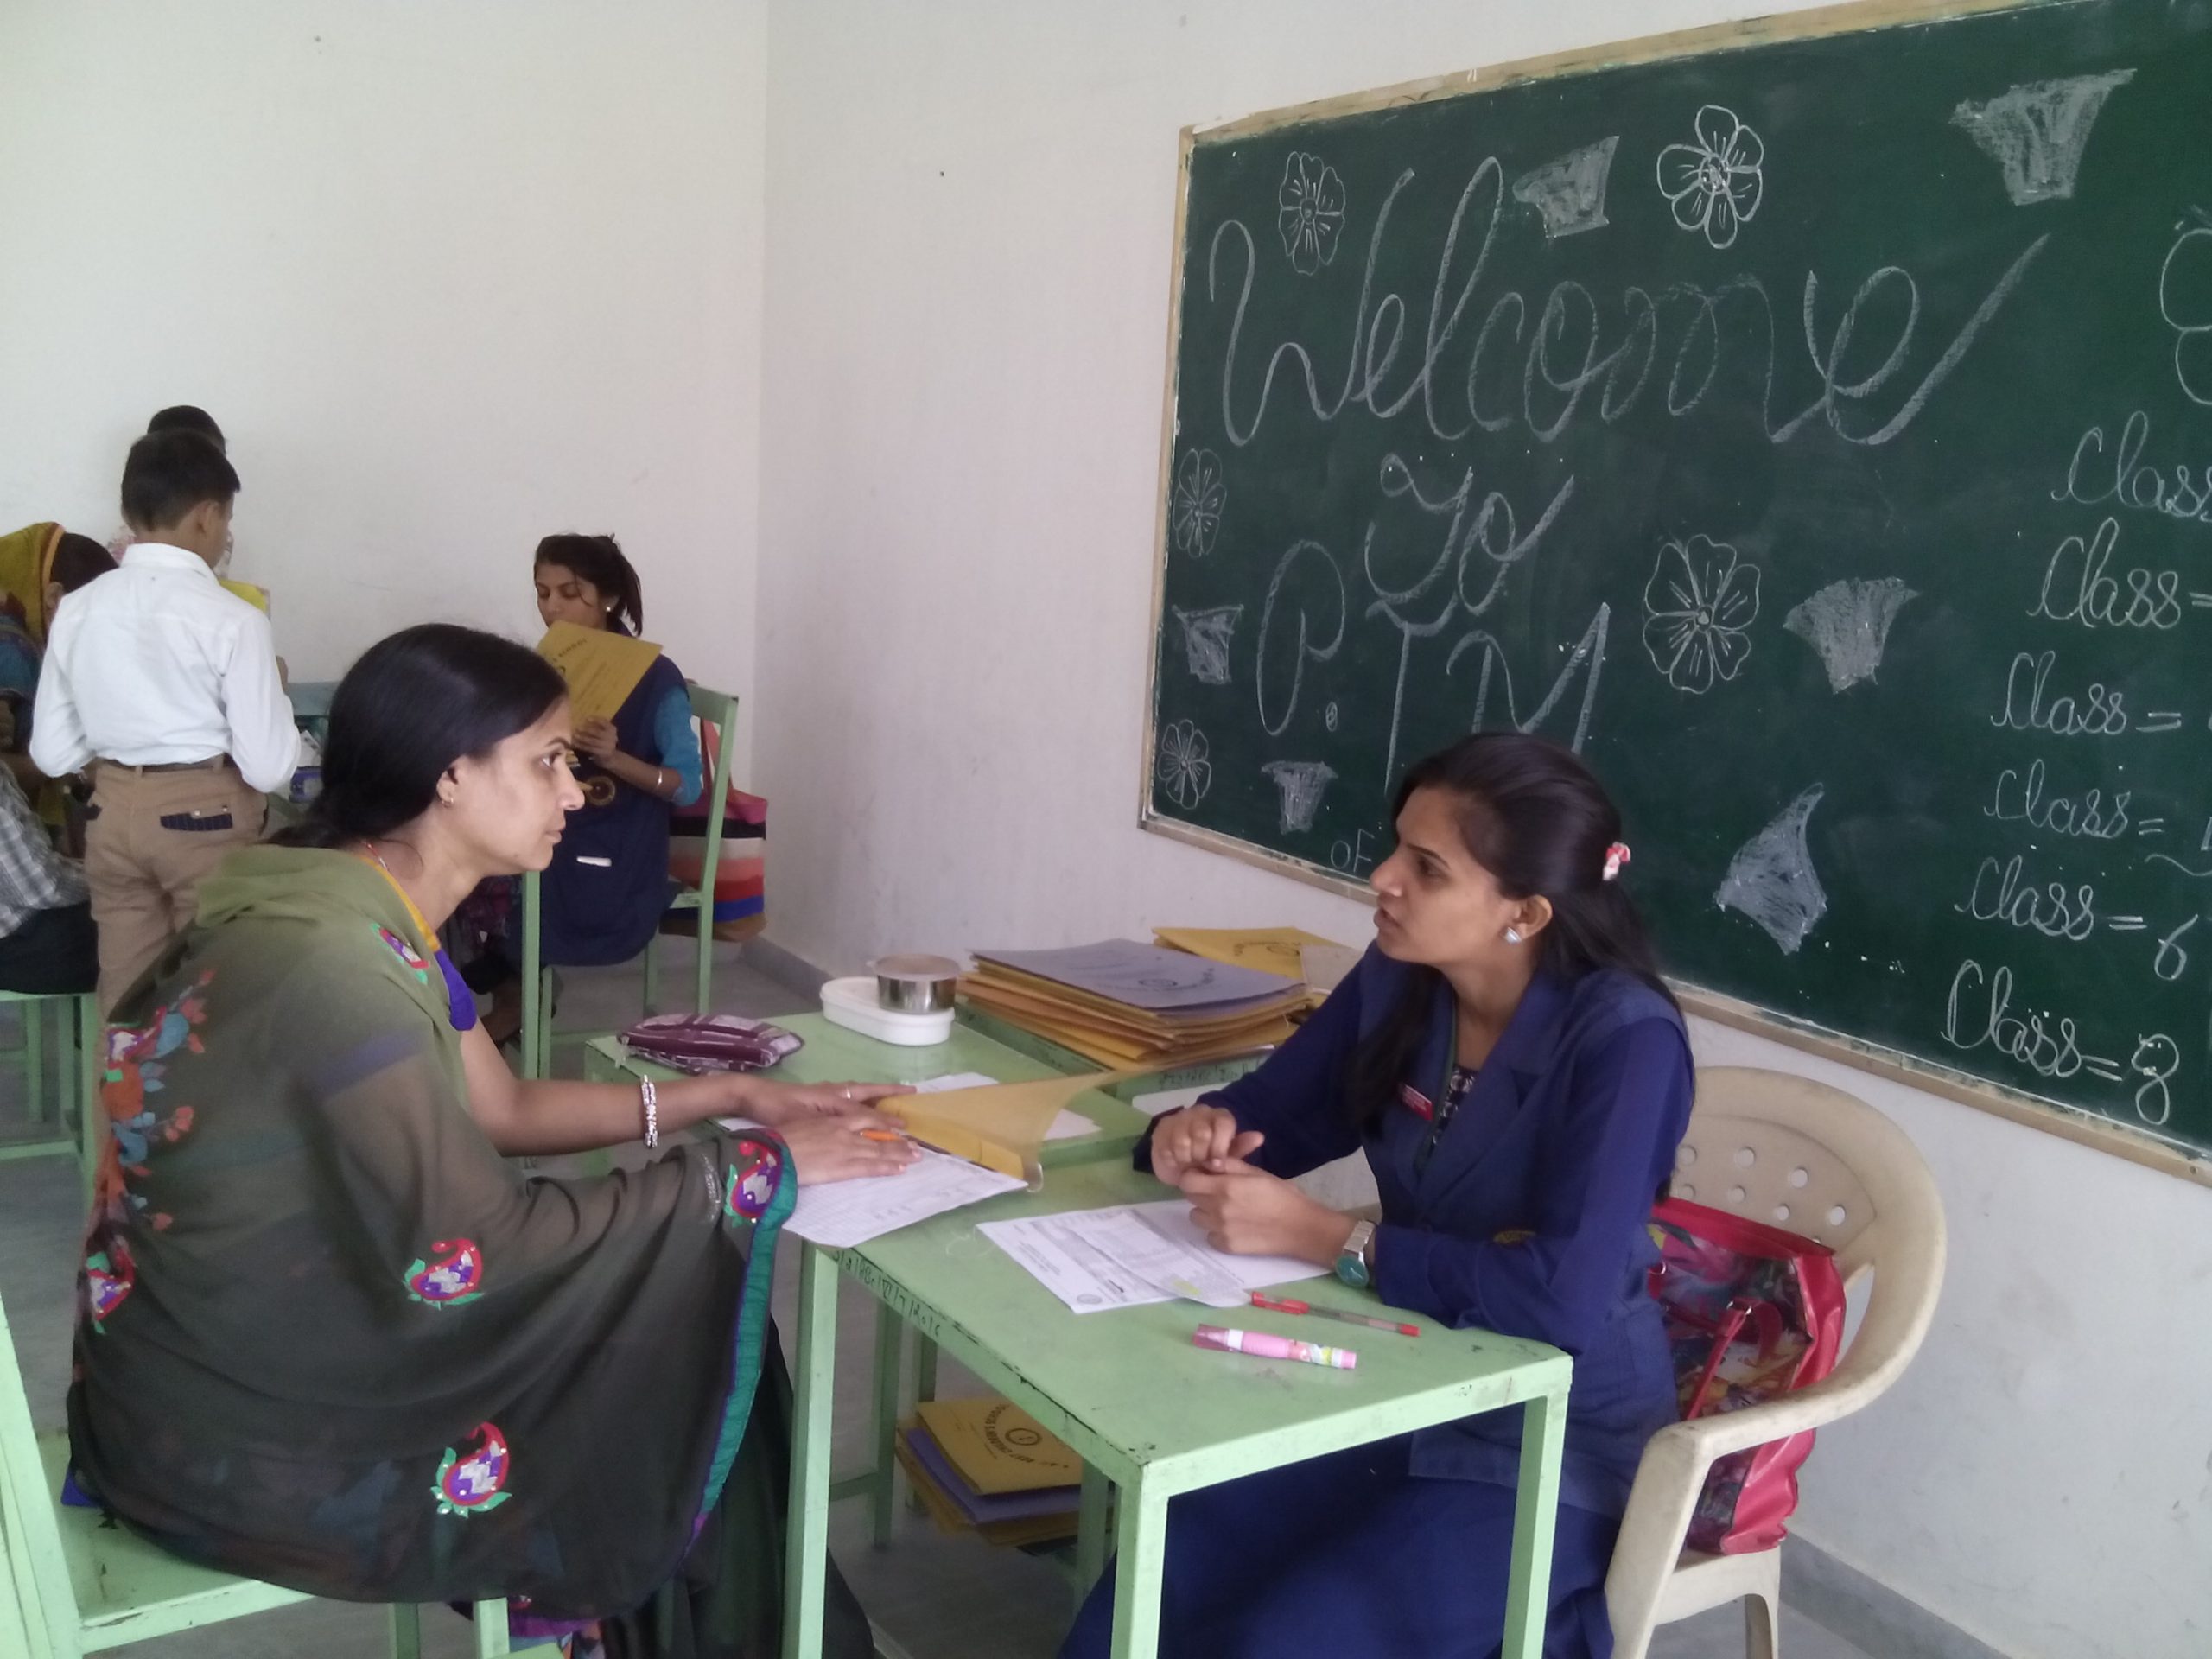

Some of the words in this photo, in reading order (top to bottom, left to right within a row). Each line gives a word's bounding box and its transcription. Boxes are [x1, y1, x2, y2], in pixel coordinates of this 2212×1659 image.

[1209, 156, 2051, 446] Welcome
[2026, 517, 2181, 628] Class
[1990, 650, 2127, 735] Class
[1954, 855, 2094, 940] Class
[1940, 959, 2082, 1078] Class
